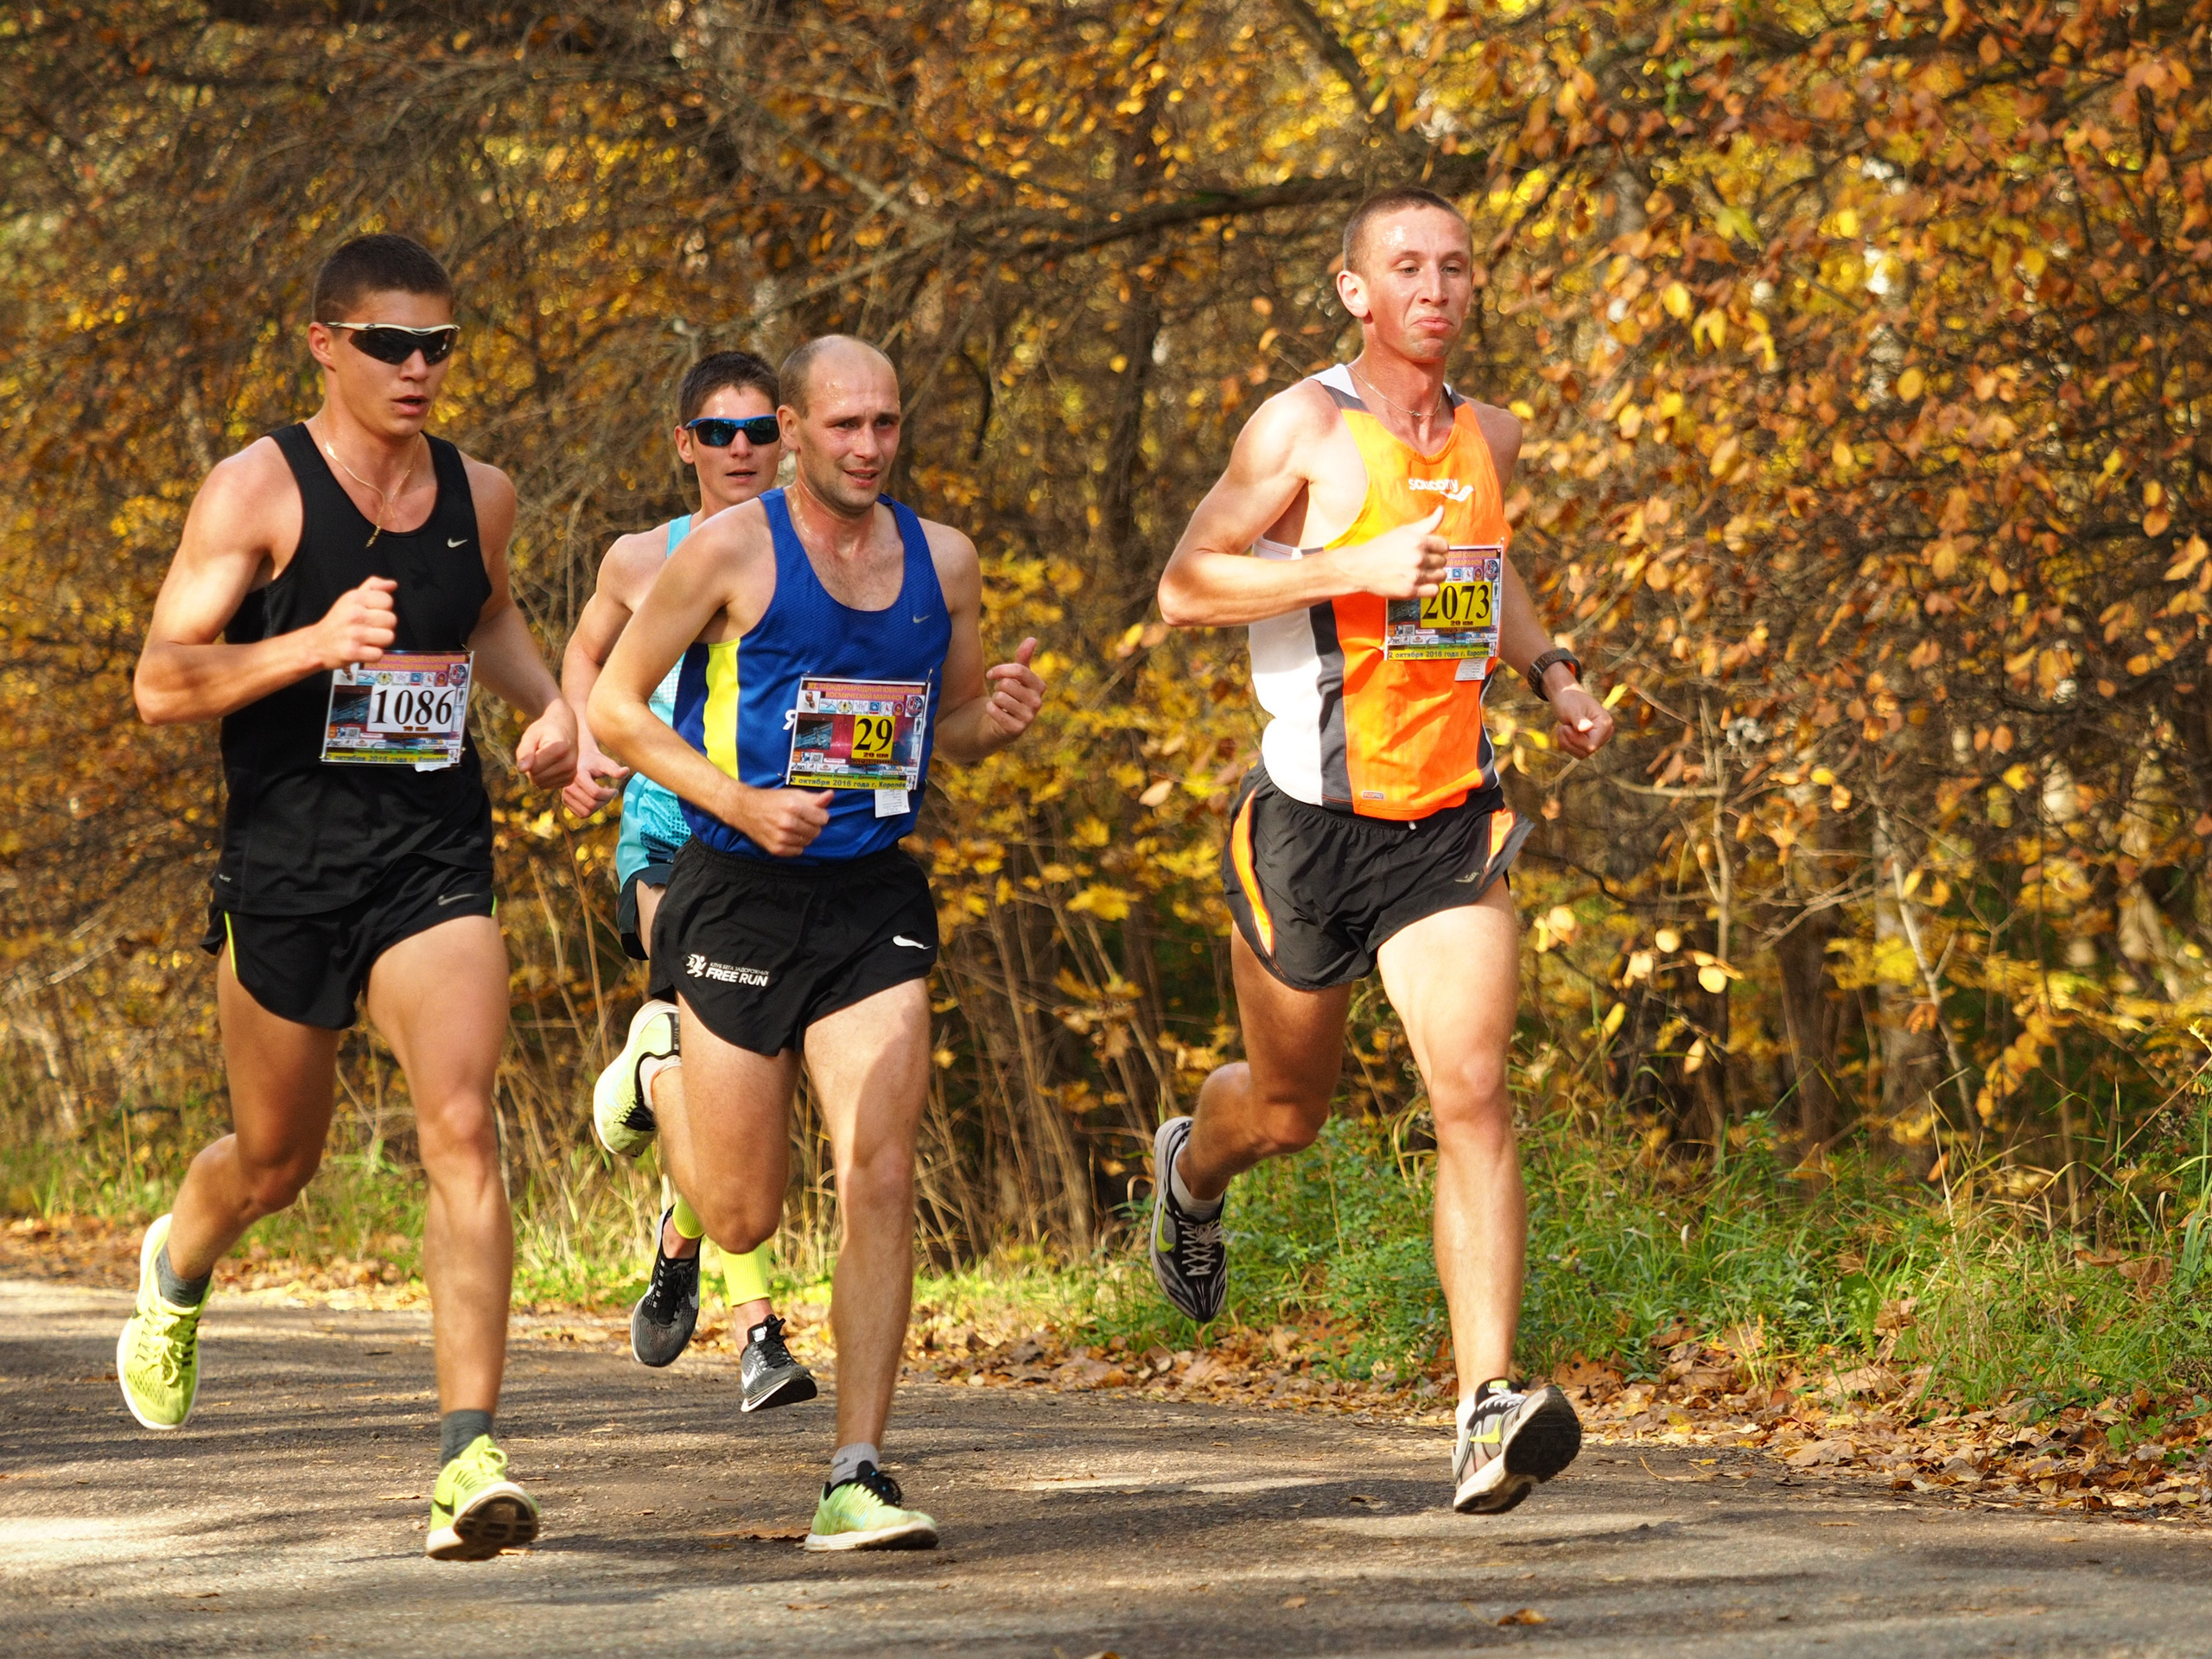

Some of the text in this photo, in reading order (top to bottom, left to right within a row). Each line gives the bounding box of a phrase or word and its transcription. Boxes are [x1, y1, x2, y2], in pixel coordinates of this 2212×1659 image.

[1422, 585, 1490, 620] 2073
[371, 690, 455, 725] 1086
[854, 718, 893, 752] 29
[879, 780, 906, 789] Королёв
[705, 966, 769, 988] FREE RUN
